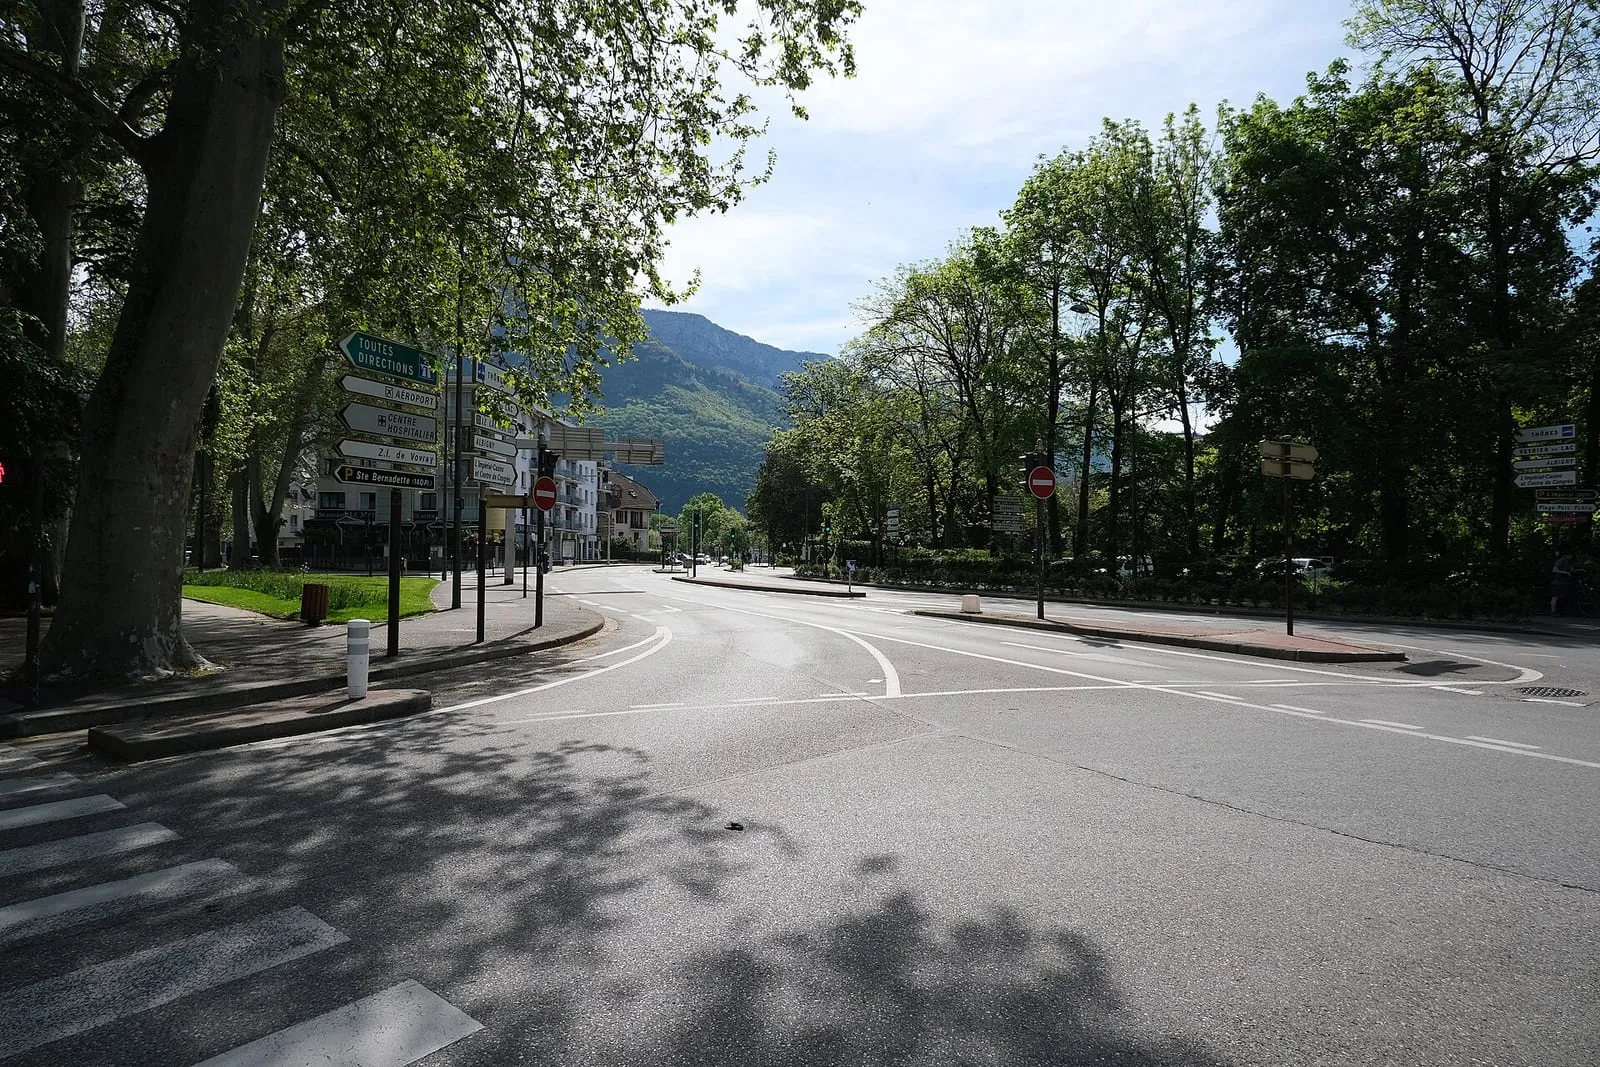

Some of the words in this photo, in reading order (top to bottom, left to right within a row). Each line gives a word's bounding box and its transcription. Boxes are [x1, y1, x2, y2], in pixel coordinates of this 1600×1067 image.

[358, 337, 394, 357] TOUTES
[358, 351, 415, 376] DIRECTIONS
[395, 388, 435, 407] AÉROPORT
[387, 413, 417, 427] CENTRE
[387, 425, 435, 440] HOSPITALIER
[378, 448, 391, 458] Z.I.
[396, 450, 405, 460] de
[410, 452, 435, 465] Vovray
[344, 467, 353, 481] P
[356, 470, 369, 481] Ste
[372, 472, 410, 485] Bernadette
